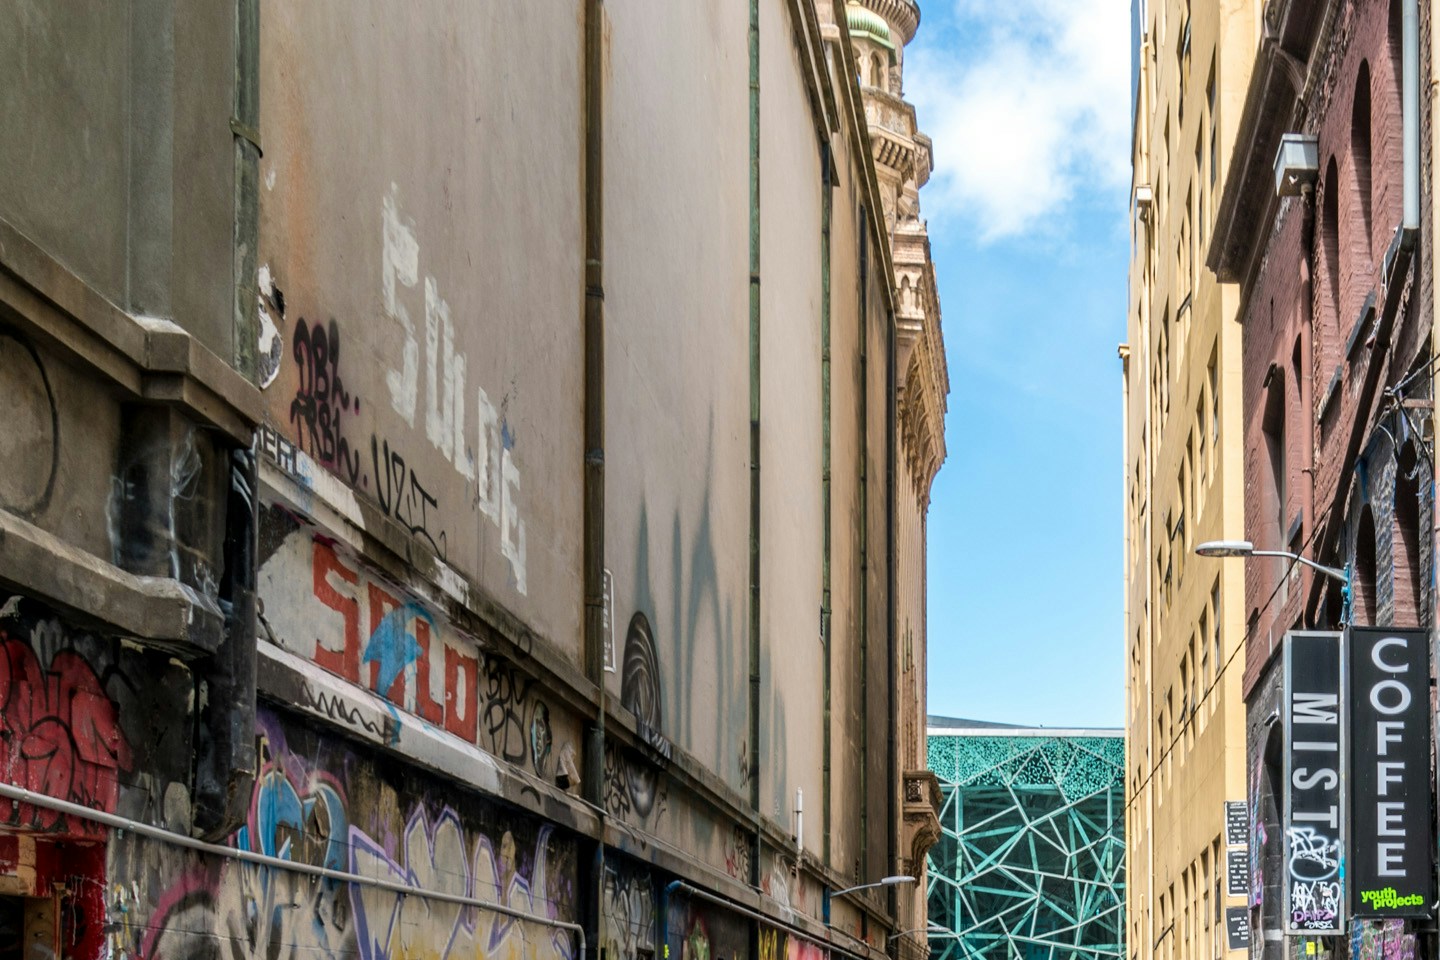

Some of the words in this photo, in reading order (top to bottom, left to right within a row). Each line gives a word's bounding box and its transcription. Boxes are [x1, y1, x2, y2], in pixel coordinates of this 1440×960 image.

[1292, 692, 1339, 829] MIST
[1368, 636, 1412, 878] COFFEE
[1361, 886, 1397, 903] youth
[1373, 892, 1424, 911] projects
